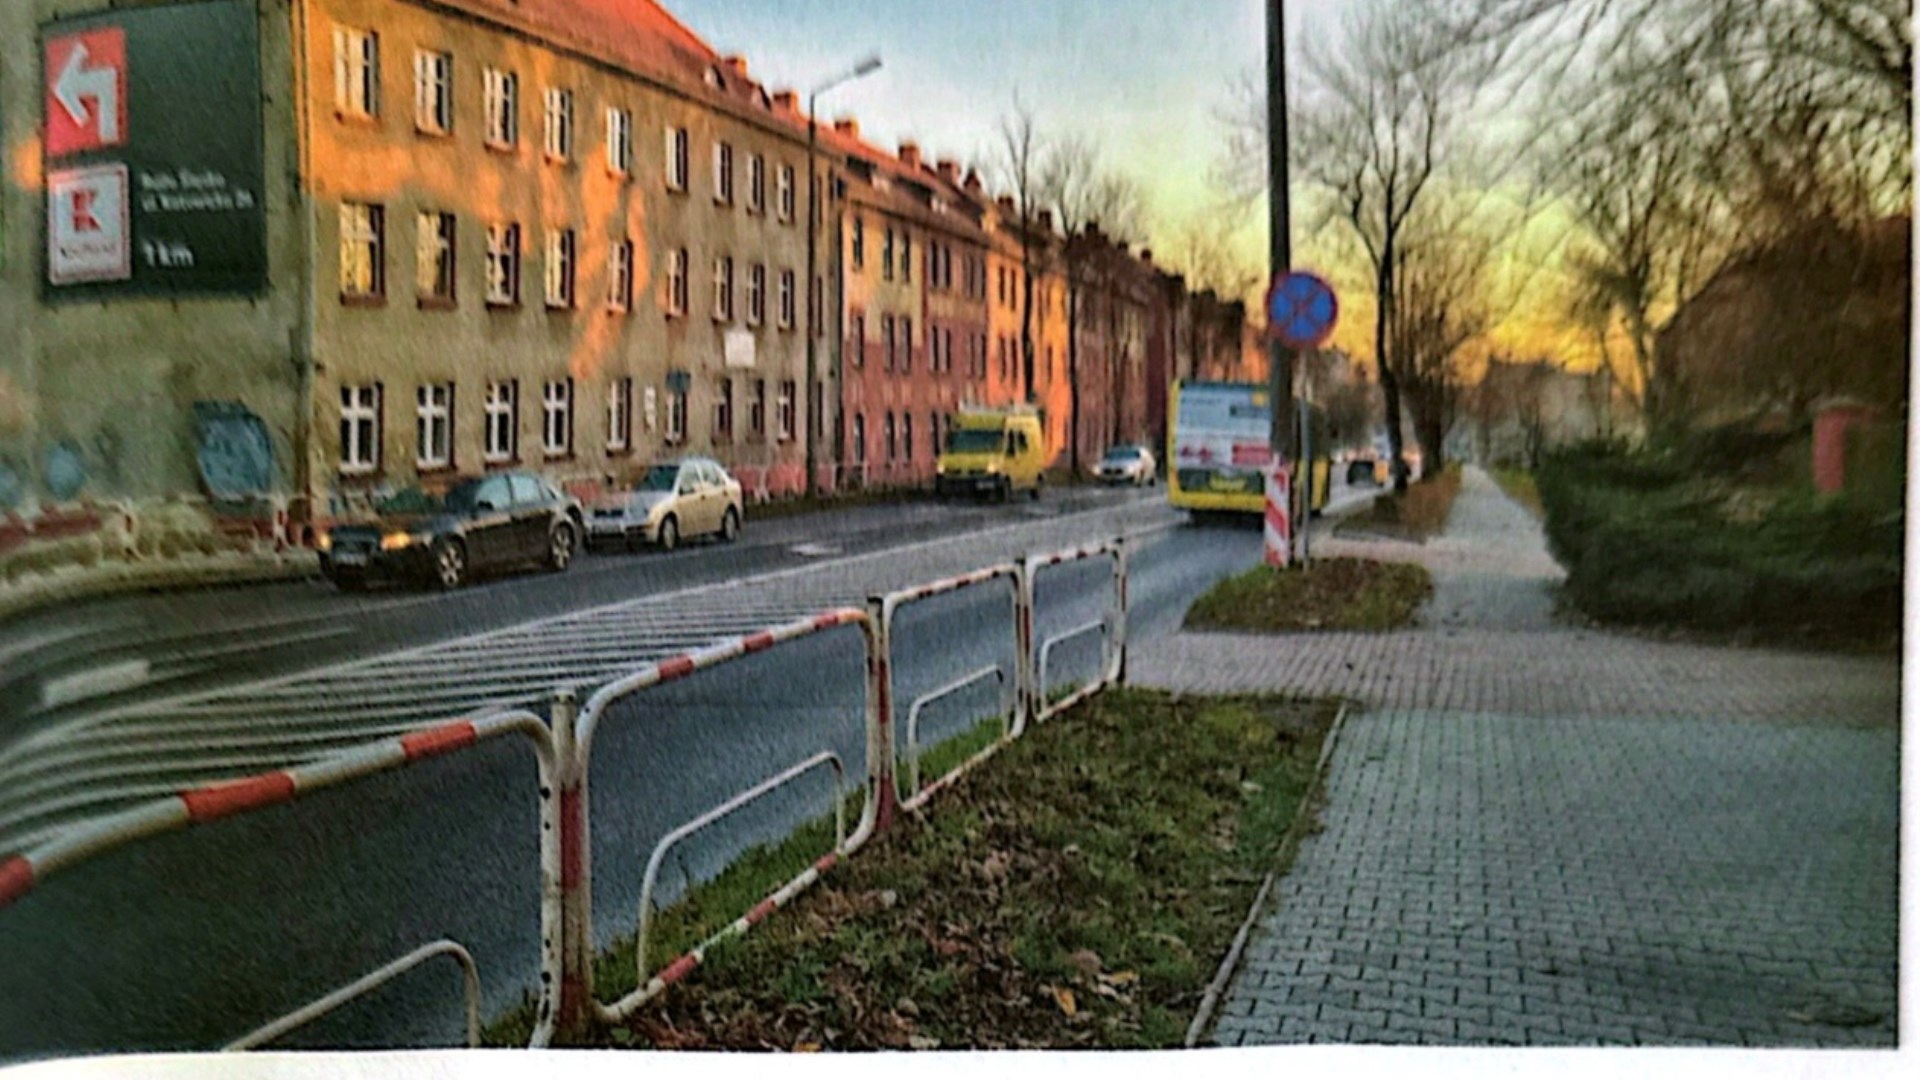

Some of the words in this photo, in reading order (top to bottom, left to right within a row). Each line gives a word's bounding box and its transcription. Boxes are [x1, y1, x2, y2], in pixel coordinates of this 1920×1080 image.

[71, 189, 101, 233] K
[143, 241, 155, 267] 1
[157, 240, 194, 267] km
